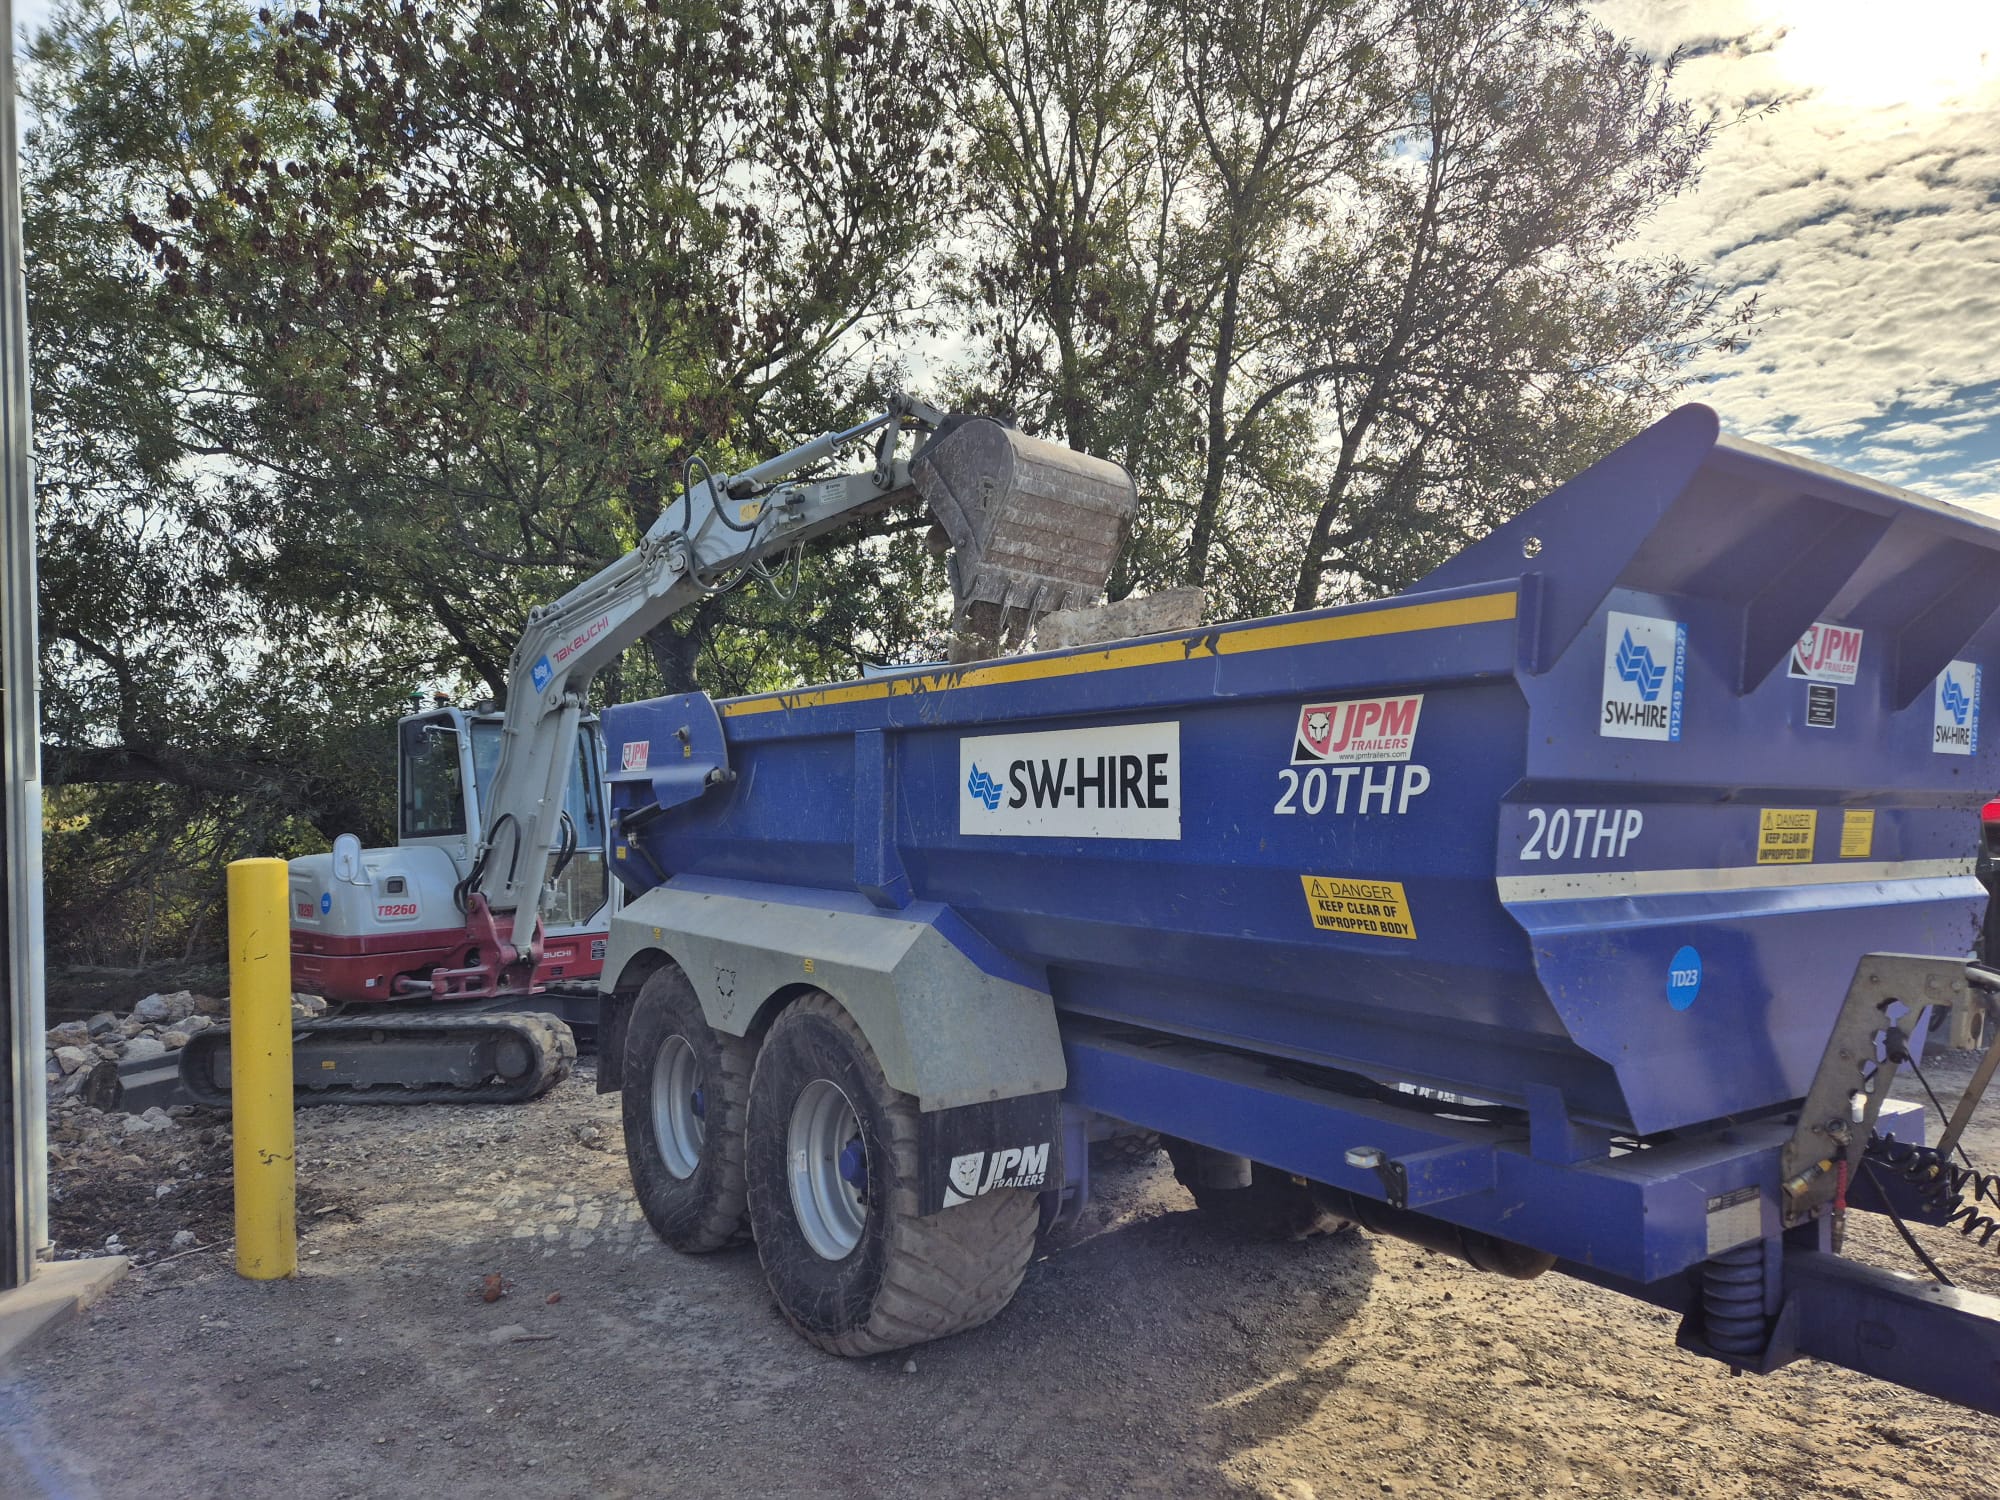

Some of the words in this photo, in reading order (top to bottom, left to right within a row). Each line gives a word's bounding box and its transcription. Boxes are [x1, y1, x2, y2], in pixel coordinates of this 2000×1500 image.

[552, 616, 609, 663] TAKEUCHI
[1814, 628, 1861, 670] JPM
[1674, 627, 1687, 684] 730927
[1332, 698, 1419, 753] JPM
[1604, 700, 1668, 728] SW-HIRE
[1671, 690, 1683, 737] 01249
[1351, 738, 1408, 751] TRAILERS
[1935, 725, 1970, 745] SW-HIRE
[631, 743, 648, 766] JPM
[1338, 750, 1407, 761] www.jpmtrailers.com
[1008, 753, 1169, 809] SW-HIRE
[1273, 764, 1431, 815] 20THP
[1519, 808, 1644, 860] 20THP
[1330, 882, 1394, 900] DANGER
[377, 903, 417, 917] TB260
[1318, 900, 1344, 912] KEEP
[1346, 902, 1381, 917] CLEAR
[1383, 905, 1397, 918] OF
[1316, 914, 1378, 932] UNPROPPED
[1380, 921, 1409, 935] BODY
[1671, 969, 1699, 988] TD23
[977, 1142, 1050, 1196] JPM
[992, 1173, 1046, 1190] TRAILERS
